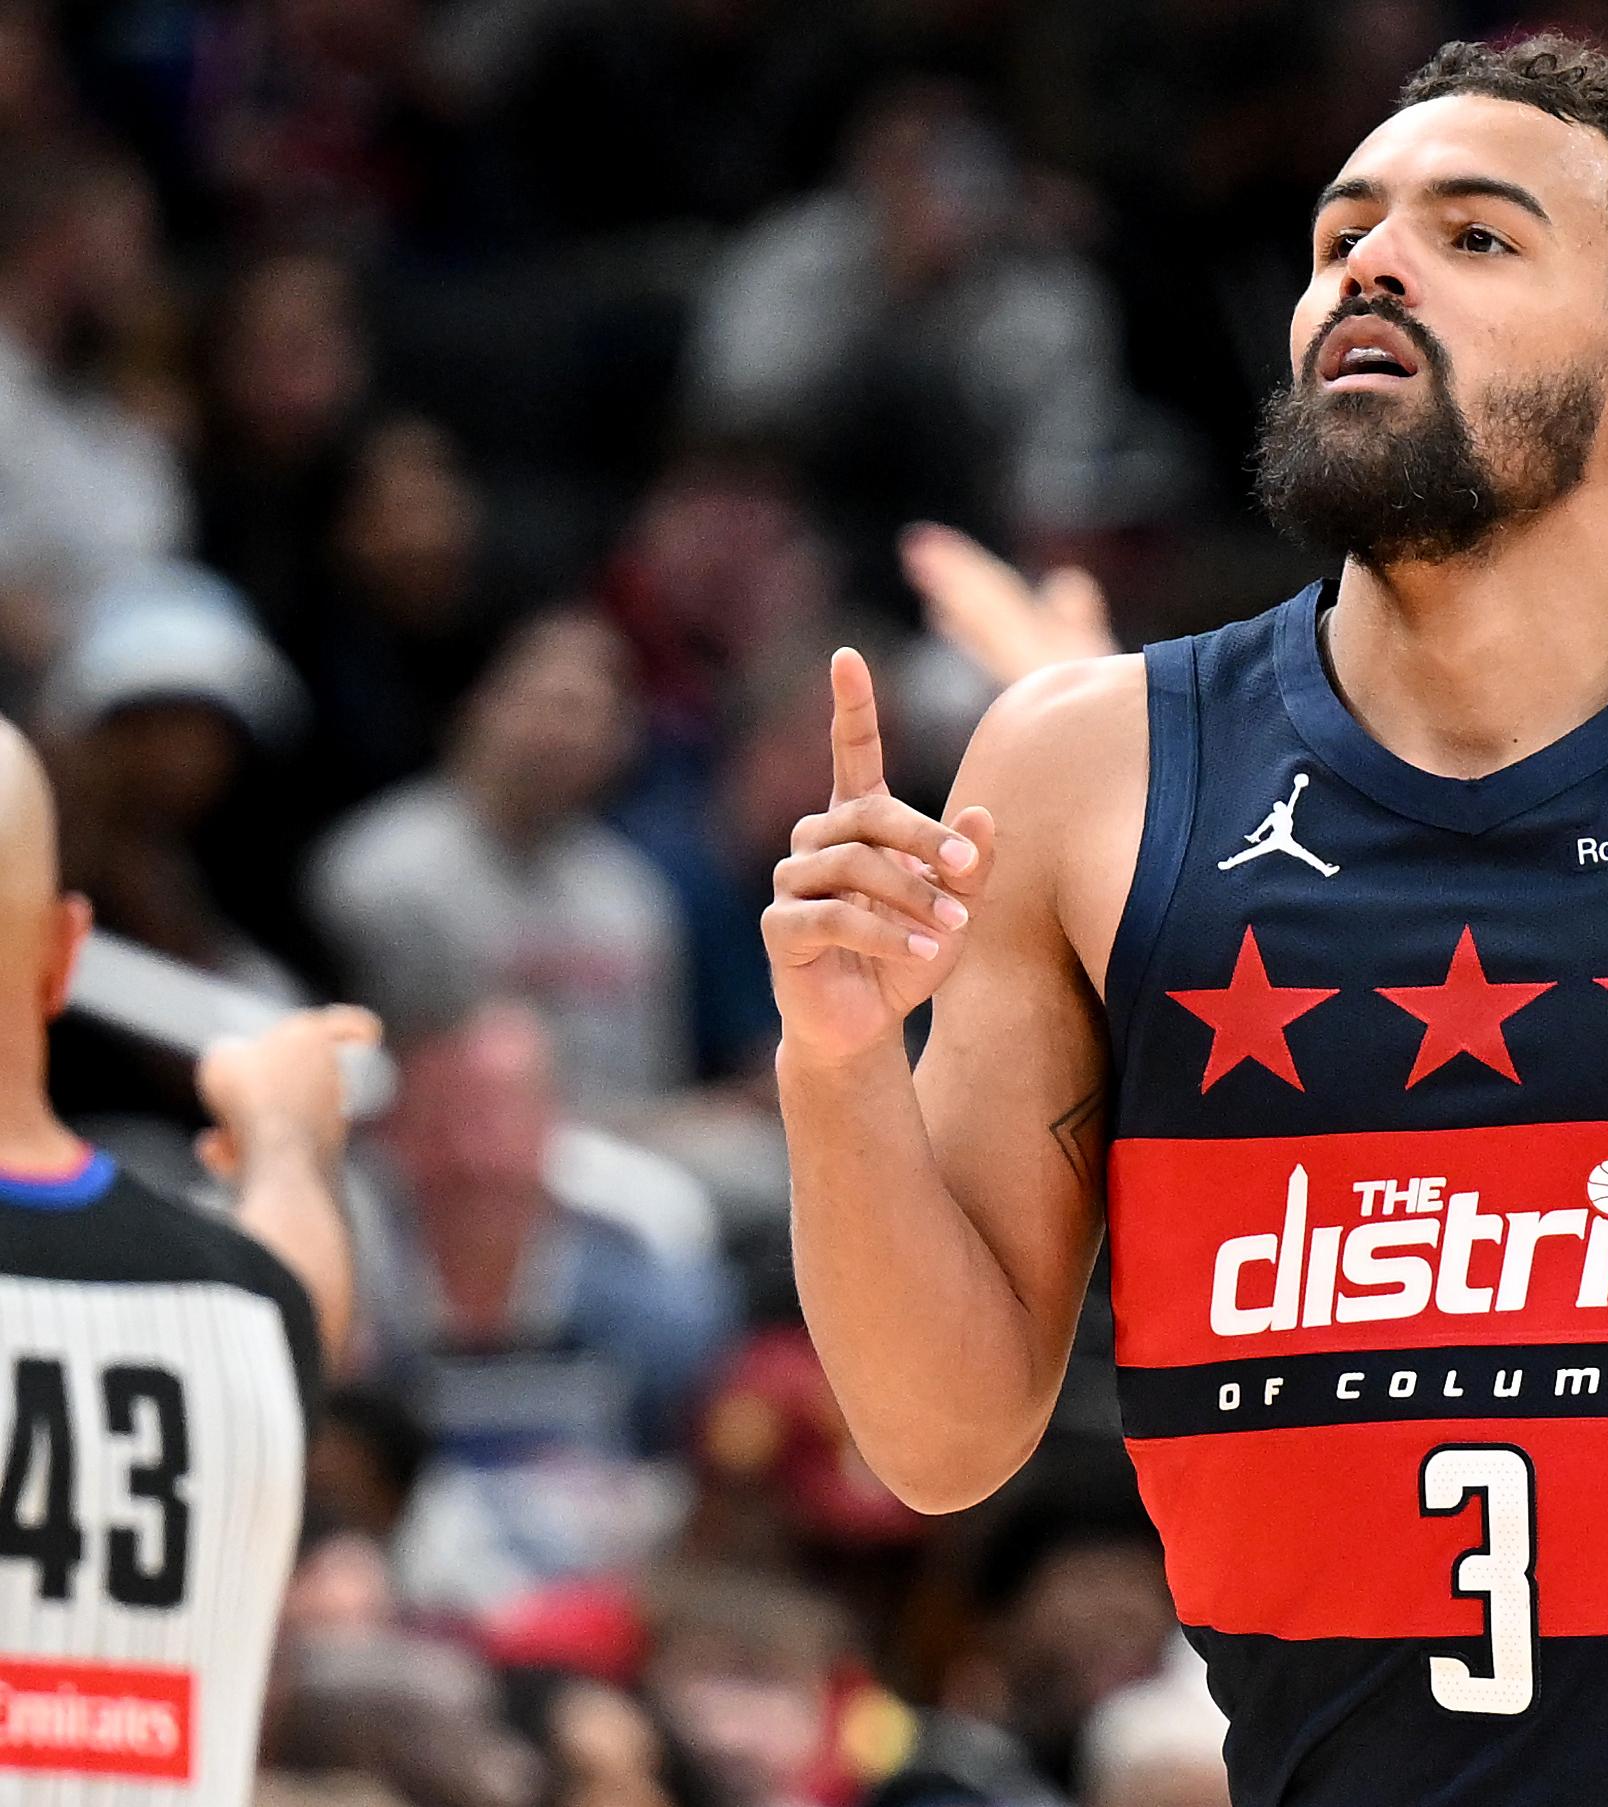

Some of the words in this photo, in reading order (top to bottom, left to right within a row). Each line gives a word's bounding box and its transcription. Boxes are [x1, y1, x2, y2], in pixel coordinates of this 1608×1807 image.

[1352, 1175, 1448, 1218] THE
[1217, 1376, 1285, 1412] OF
[0, 1355, 191, 1613] 43
[1421, 1445, 1537, 1718] 3
